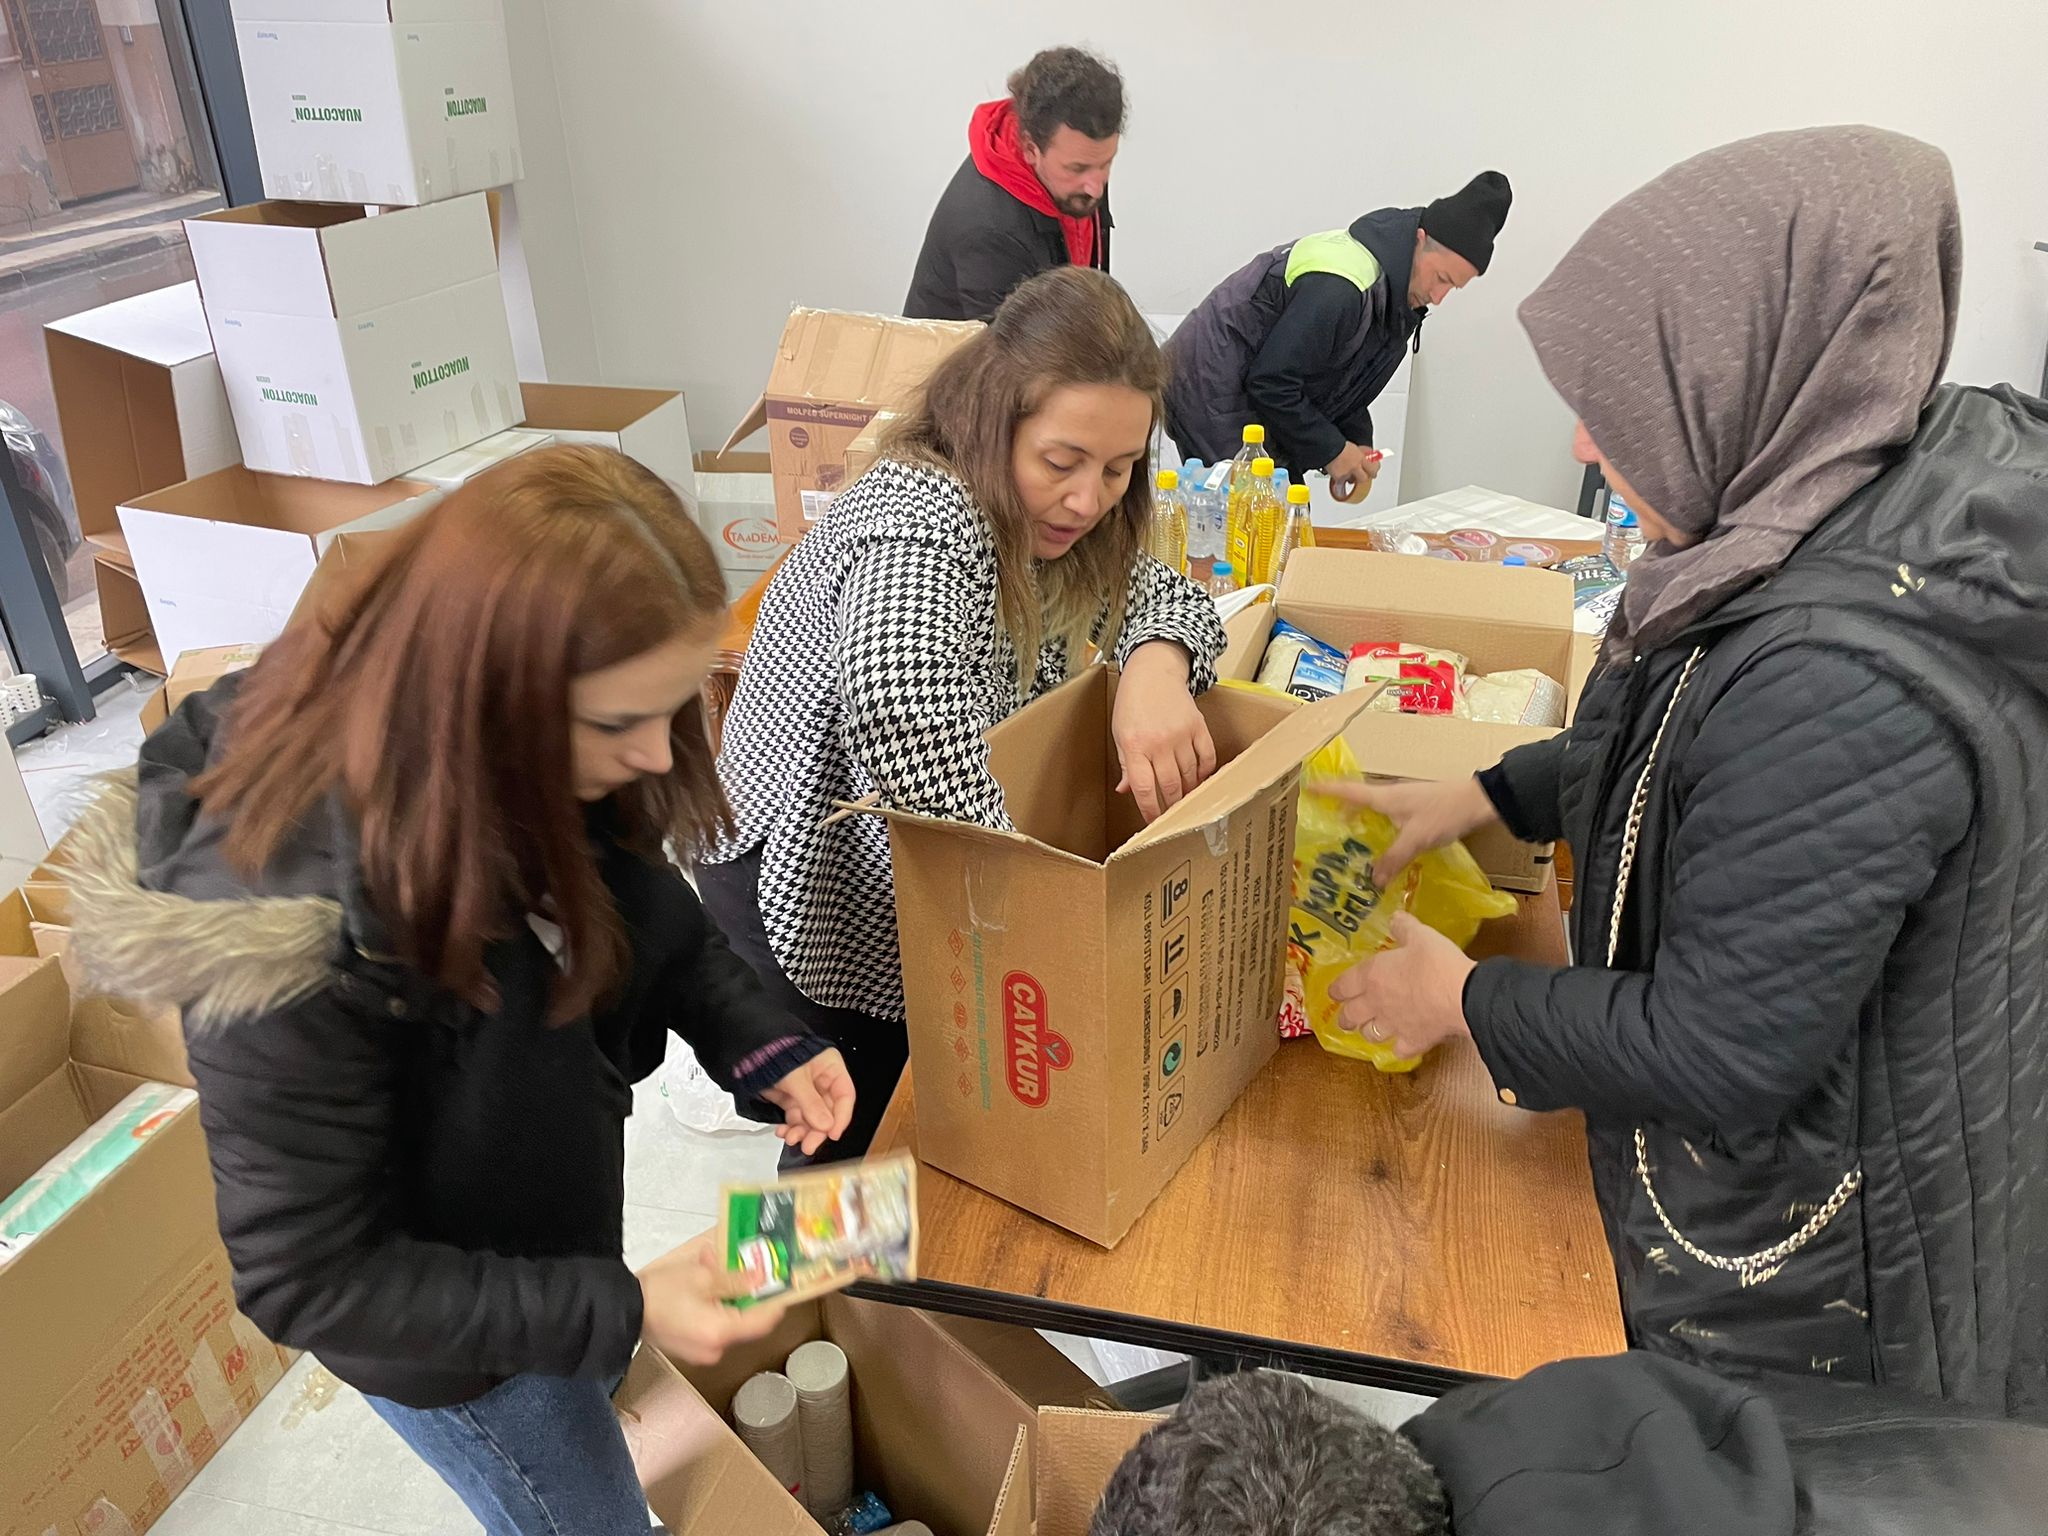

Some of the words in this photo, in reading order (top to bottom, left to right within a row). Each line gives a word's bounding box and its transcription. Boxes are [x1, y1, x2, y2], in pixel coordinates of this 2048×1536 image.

[295, 107, 362, 121] NUACOTTON
[447, 97, 488, 118] NUACOTTON
[413, 356, 471, 390] NUACOTTON
[262, 388, 318, 406] NUACOTTON
[820, 409, 868, 422] SUPERNIGHT
[1173, 875, 1188, 903] 8
[1143, 888, 1154, 921] KOLİ
[1142, 919, 1151, 988] BOYUTLARI
[1007, 982, 1038, 1099] ÇAYKUR
[1142, 992, 1151, 1066] DIMENSIONS
